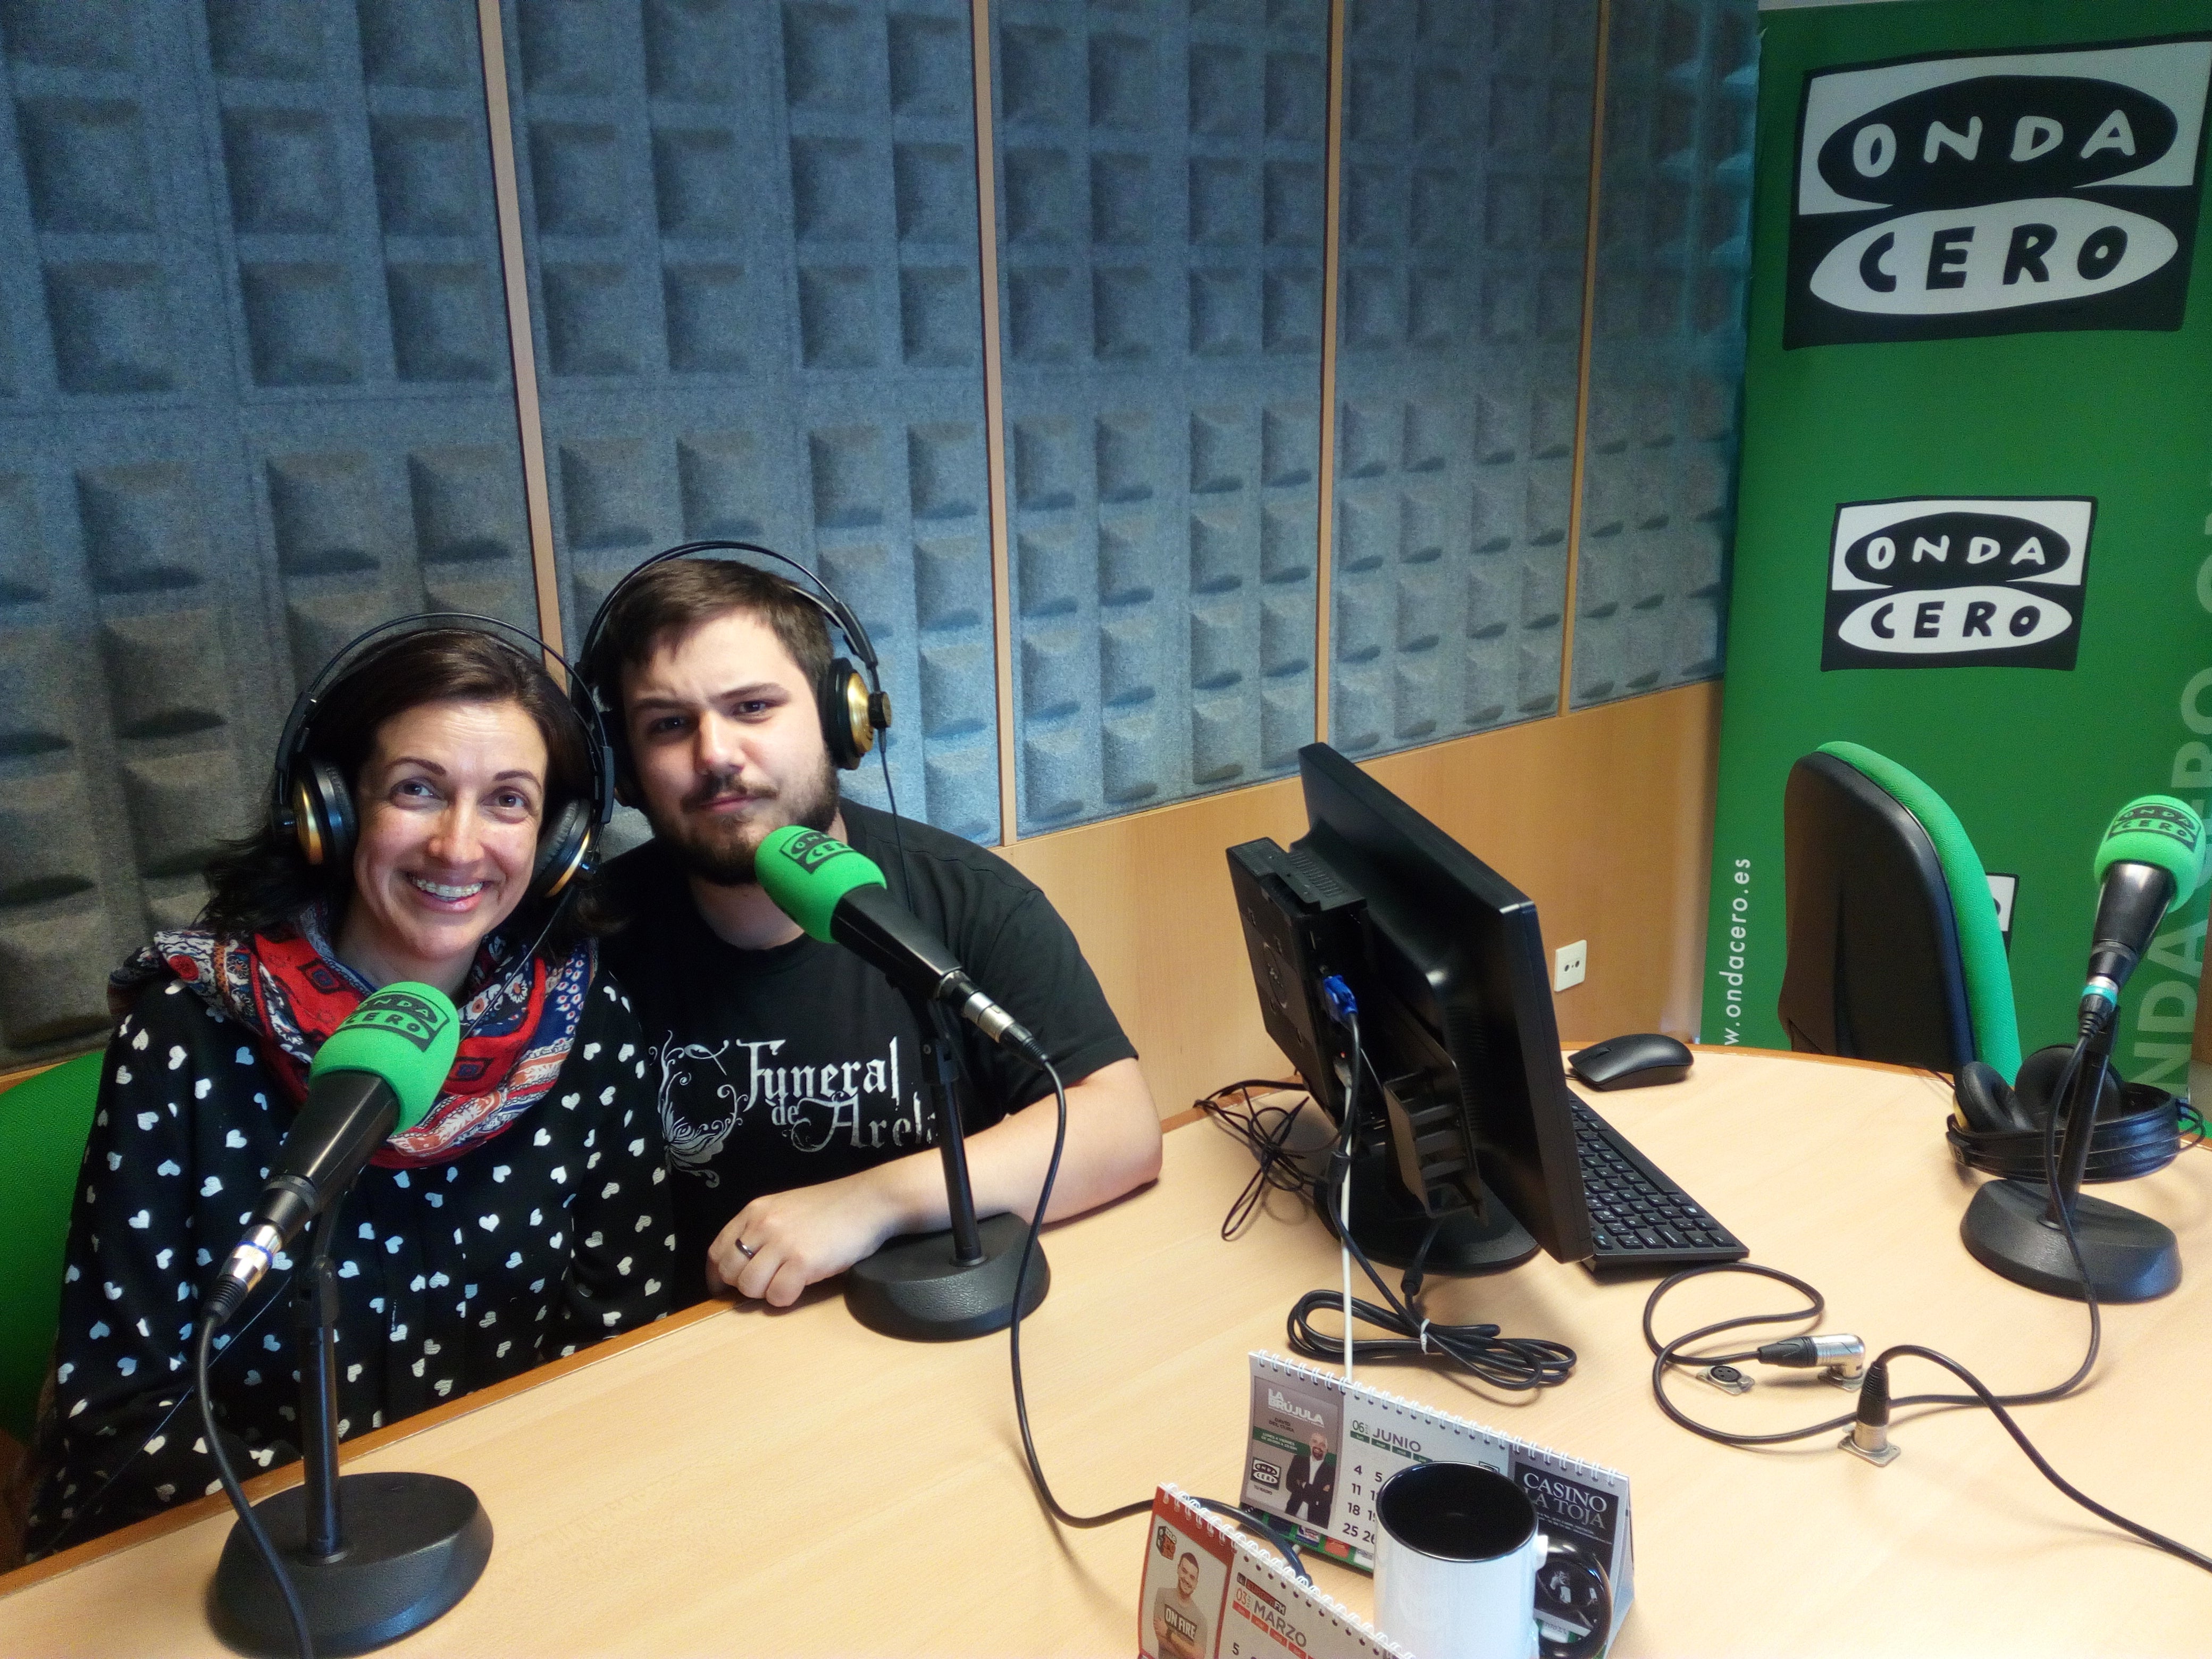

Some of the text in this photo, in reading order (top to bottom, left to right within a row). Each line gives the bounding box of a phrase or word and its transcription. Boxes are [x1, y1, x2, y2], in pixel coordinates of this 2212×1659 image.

[1853, 110, 2135, 177] ONDA
[1859, 223, 2128, 292] CERO
[1866, 535, 2046, 569] ONDA
[1871, 601, 2041, 638] CERO
[2122, 819, 2188, 836] CERO
[2124, 809, 2189, 825] ONDA
[736, 1036, 900, 1112] Funeral
[765, 1097, 799, 1126] de
[1268, 1388, 1285, 1400] LA
[1268, 1395, 1325, 1426] BRÚJULA
[1352, 1420, 1364, 1433] 06
[1372, 1428, 1421, 1452] JUNIO
[1256, 1463, 1277, 1474] ONDA
[1256, 1472, 1275, 1482] CERO
[1354, 1465, 1382, 1482] 4 5
[1352, 1483, 1378, 1501] 11 1
[1523, 1473, 1607, 1513] CASINO
[1348, 1502, 1360, 1515] 18
[1554, 1497, 1606, 1530] TOJA
[1343, 1522, 1359, 1537] 25
[1166, 1607, 1196, 1640] ON FIRE
[1236, 1588, 1306, 1647] 03 MARZO
[1232, 1642, 1239, 1656] 5
